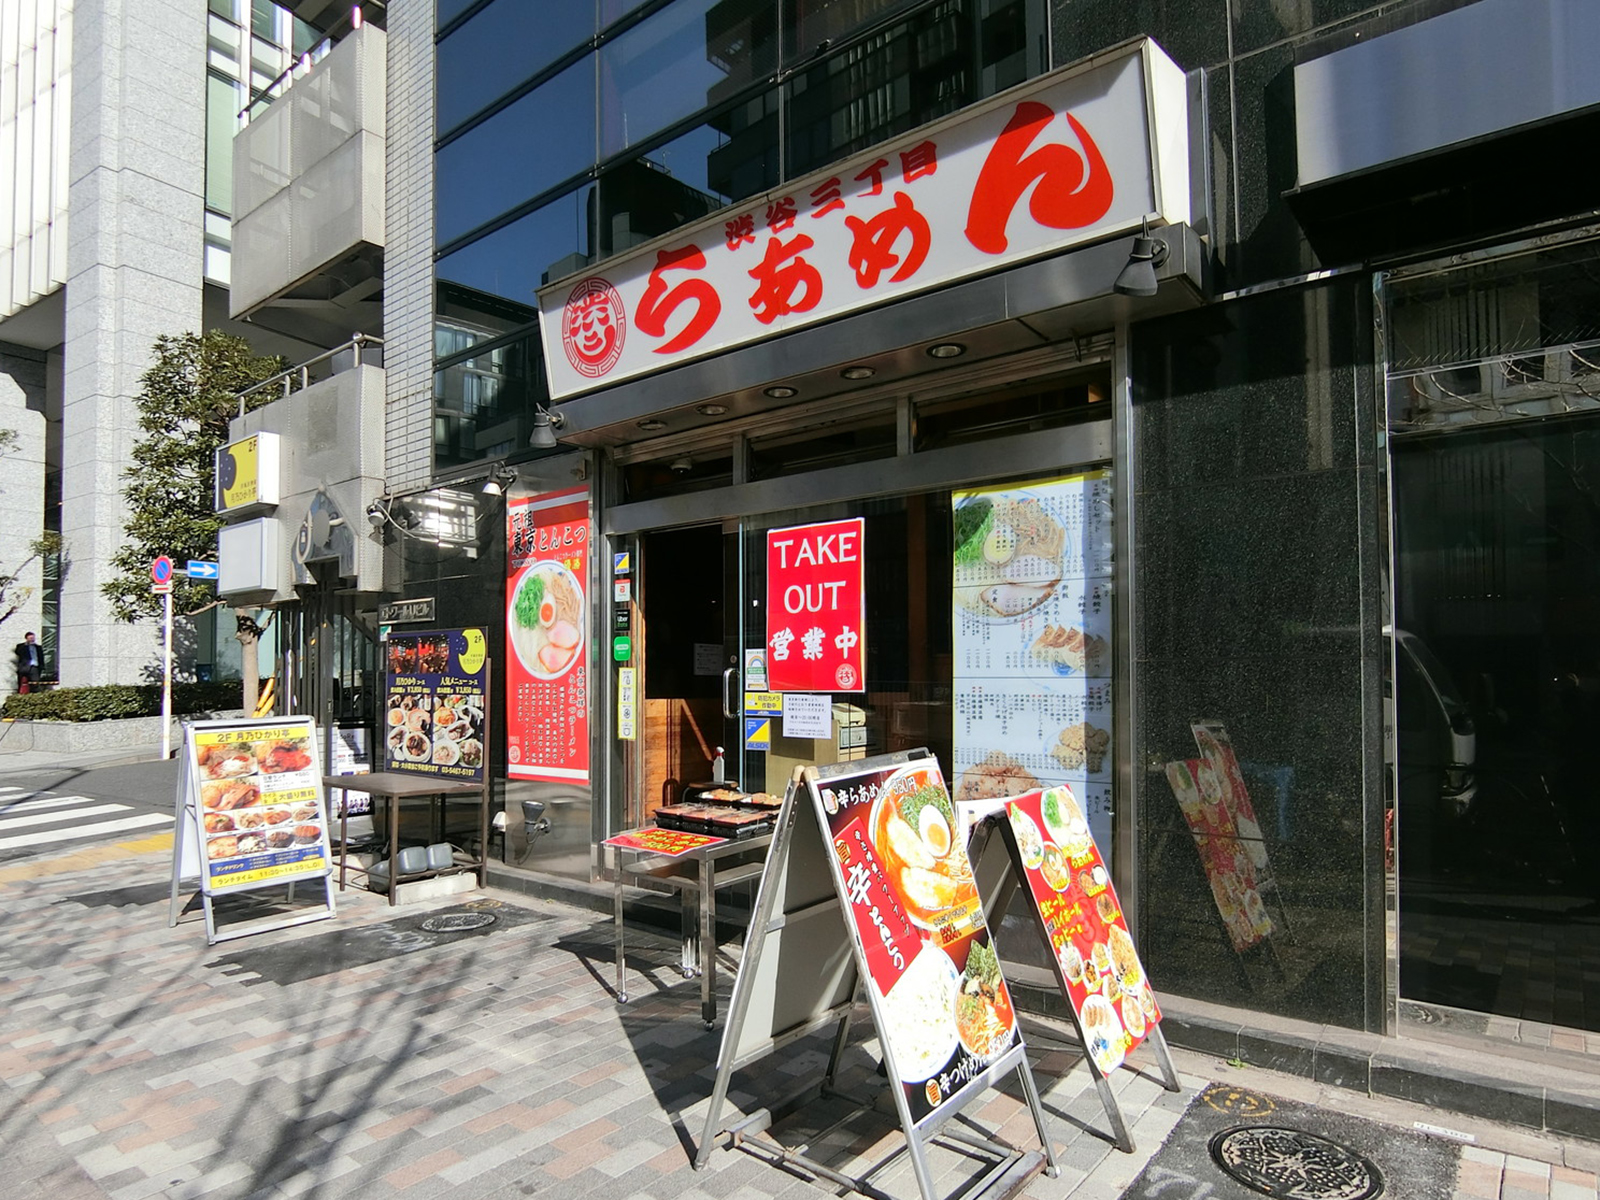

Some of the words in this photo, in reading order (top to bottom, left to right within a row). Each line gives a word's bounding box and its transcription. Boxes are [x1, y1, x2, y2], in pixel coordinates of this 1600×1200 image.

[725, 140, 938, 251] 渋谷三丁目
[634, 100, 1115, 354] らあめん
[248, 439, 257, 453] 2F
[512, 526, 587, 557] 東京とんこつ
[773, 531, 857, 569] TAKE
[783, 580, 847, 614] OUT
[474, 635, 482, 644] 2F
[769, 625, 858, 662] 営業中
[217, 733, 232, 743] 2F
[236, 729, 290, 741] 月乃ひかり亭
[1040, 893, 1066, 918] 生ビール
[1052, 902, 1083, 930] ハイボール
